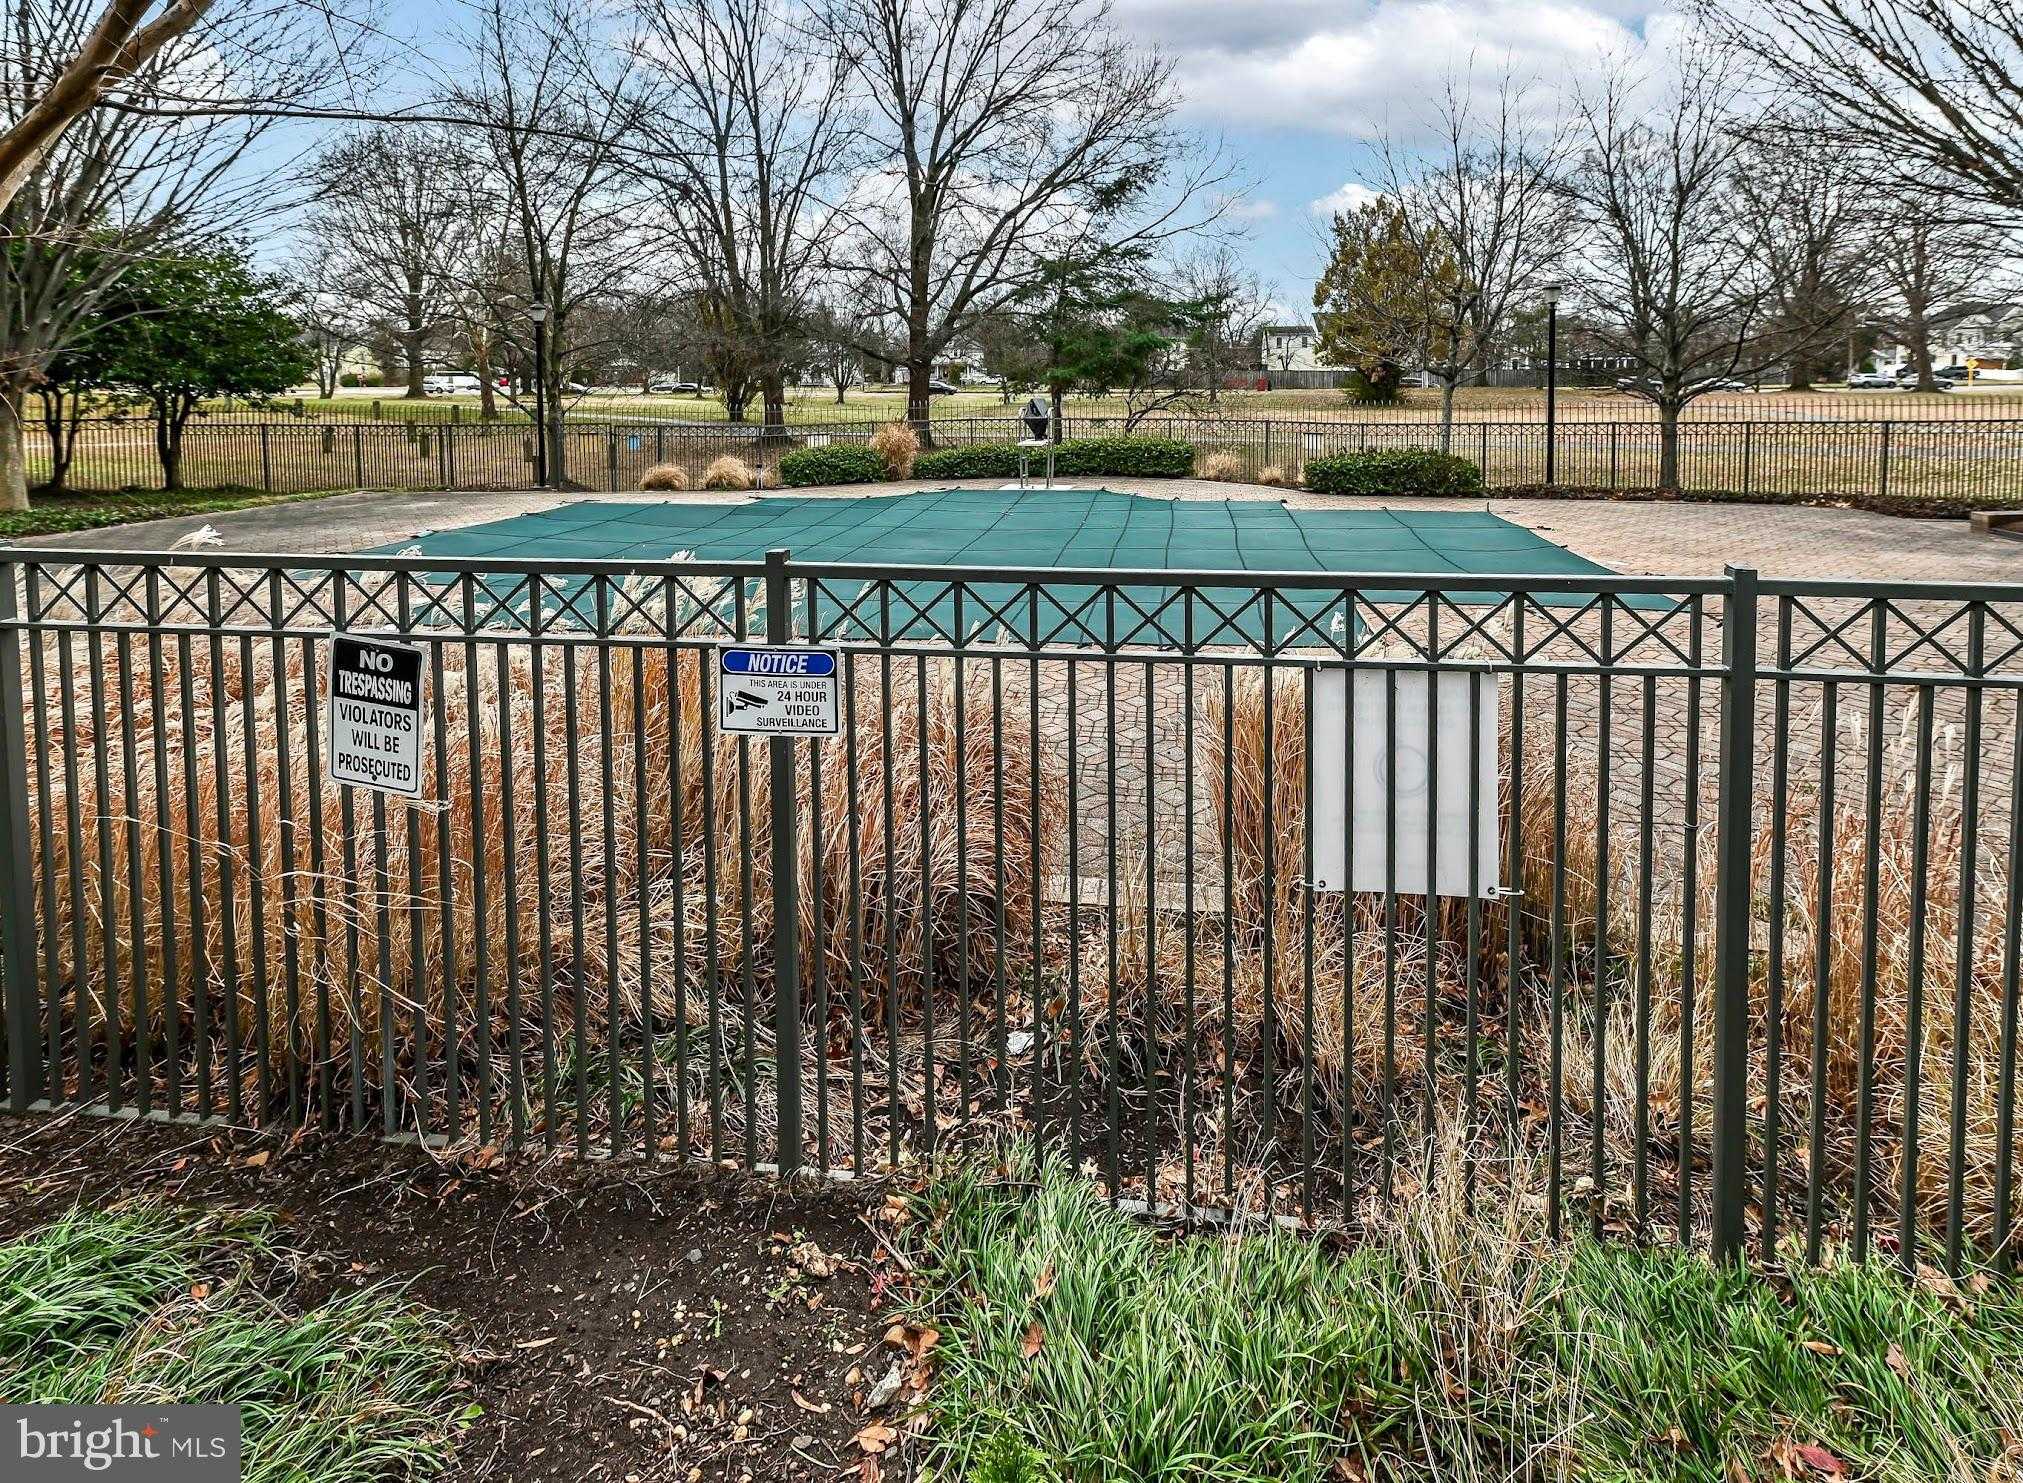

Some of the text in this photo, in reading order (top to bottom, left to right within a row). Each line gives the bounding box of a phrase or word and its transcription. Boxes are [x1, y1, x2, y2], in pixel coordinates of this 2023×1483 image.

[359, 649, 393, 672] NO
[747, 653, 809, 673] NOTICE
[339, 669, 411, 704] TRESPASSING
[750, 679, 766, 688] THIS
[767, 680, 788, 688] AREA
[800, 681, 827, 689] UNDER
[777, 690, 827, 702] 24 HOUR
[339, 703, 411, 732] VIOLATORS
[785, 704, 820, 716] VIDEO
[756, 717, 828, 728] SURVEILLANCE
[352, 729, 399, 753] WILL BE
[338, 752, 410, 781] PROSECUTED
